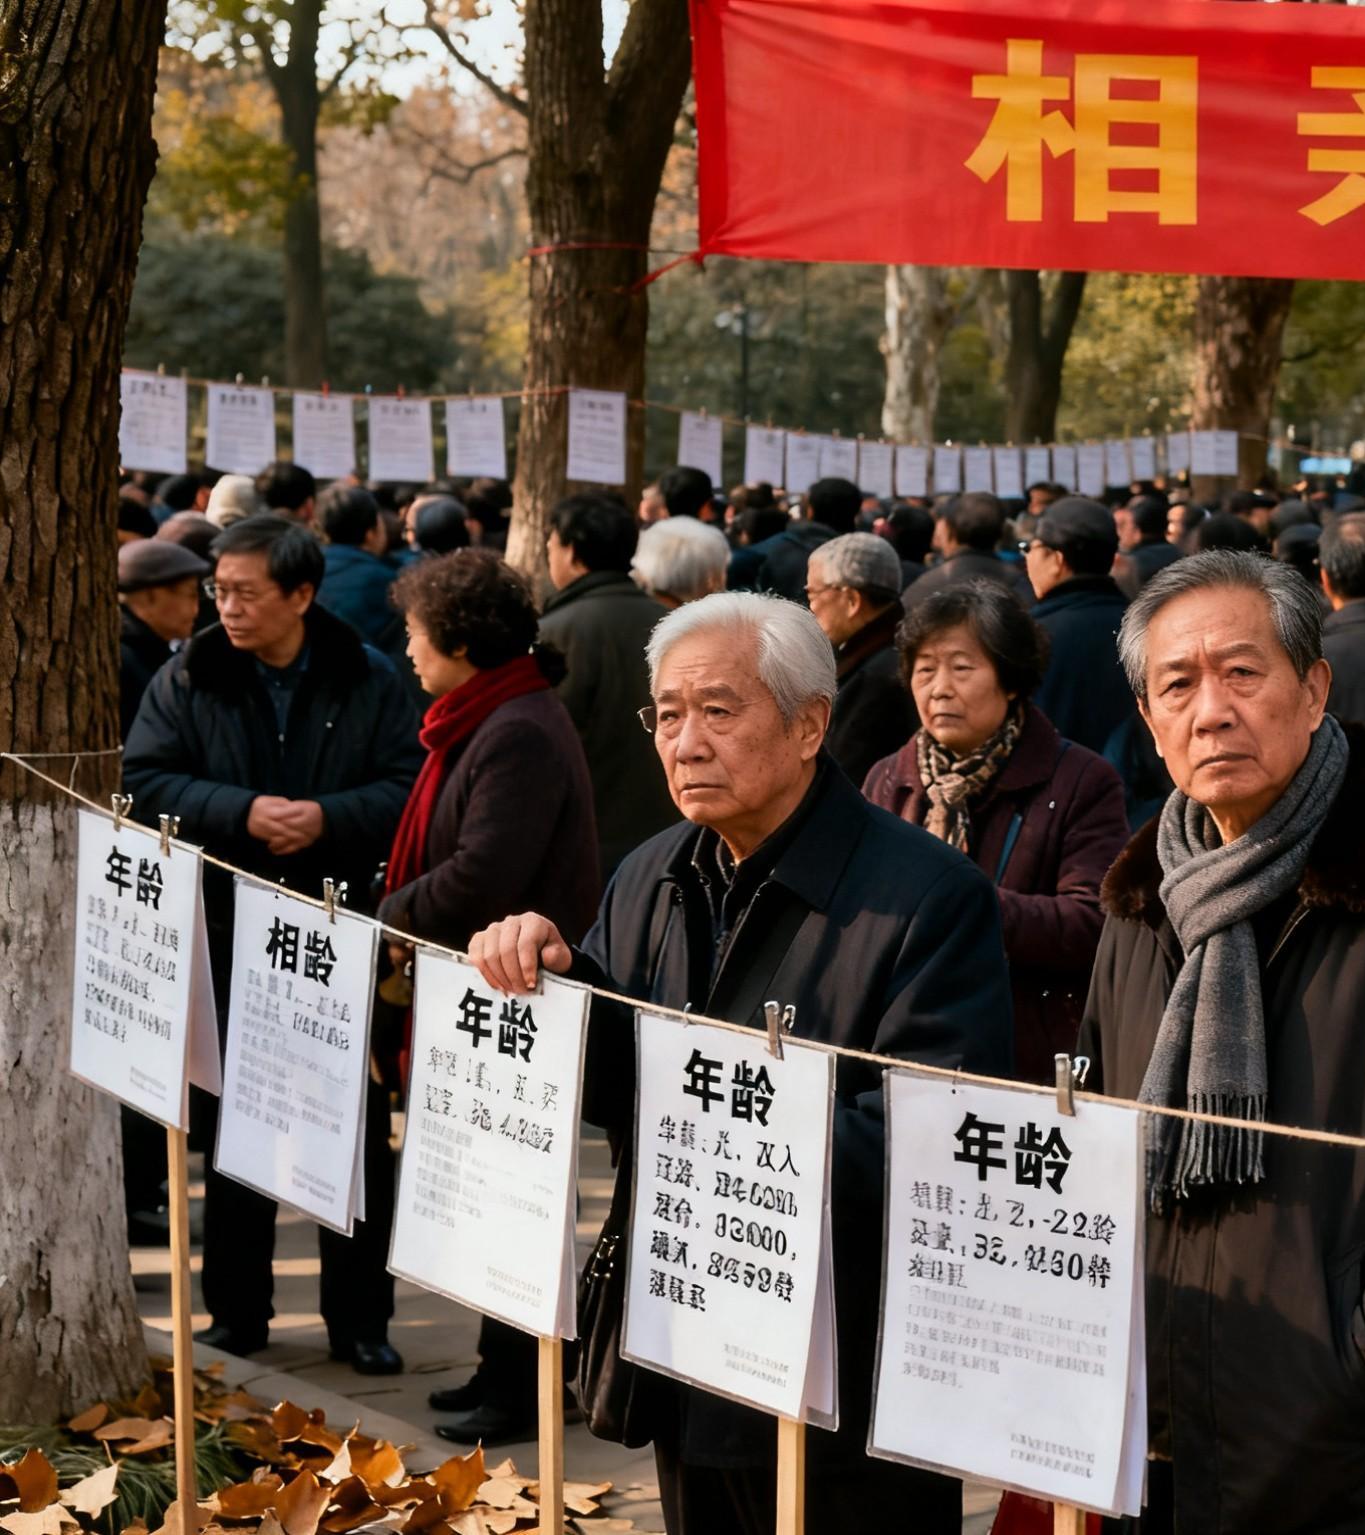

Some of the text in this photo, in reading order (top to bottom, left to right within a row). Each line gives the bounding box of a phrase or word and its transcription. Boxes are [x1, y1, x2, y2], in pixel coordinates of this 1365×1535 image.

[105, 845, 165, 911] 年龄
[266, 916, 338, 988] 相龄
[456, 988, 539, 1063] 年龄
[683, 1049, 776, 1127] 年龄
[953, 1111, 1073, 1195] 年龄
